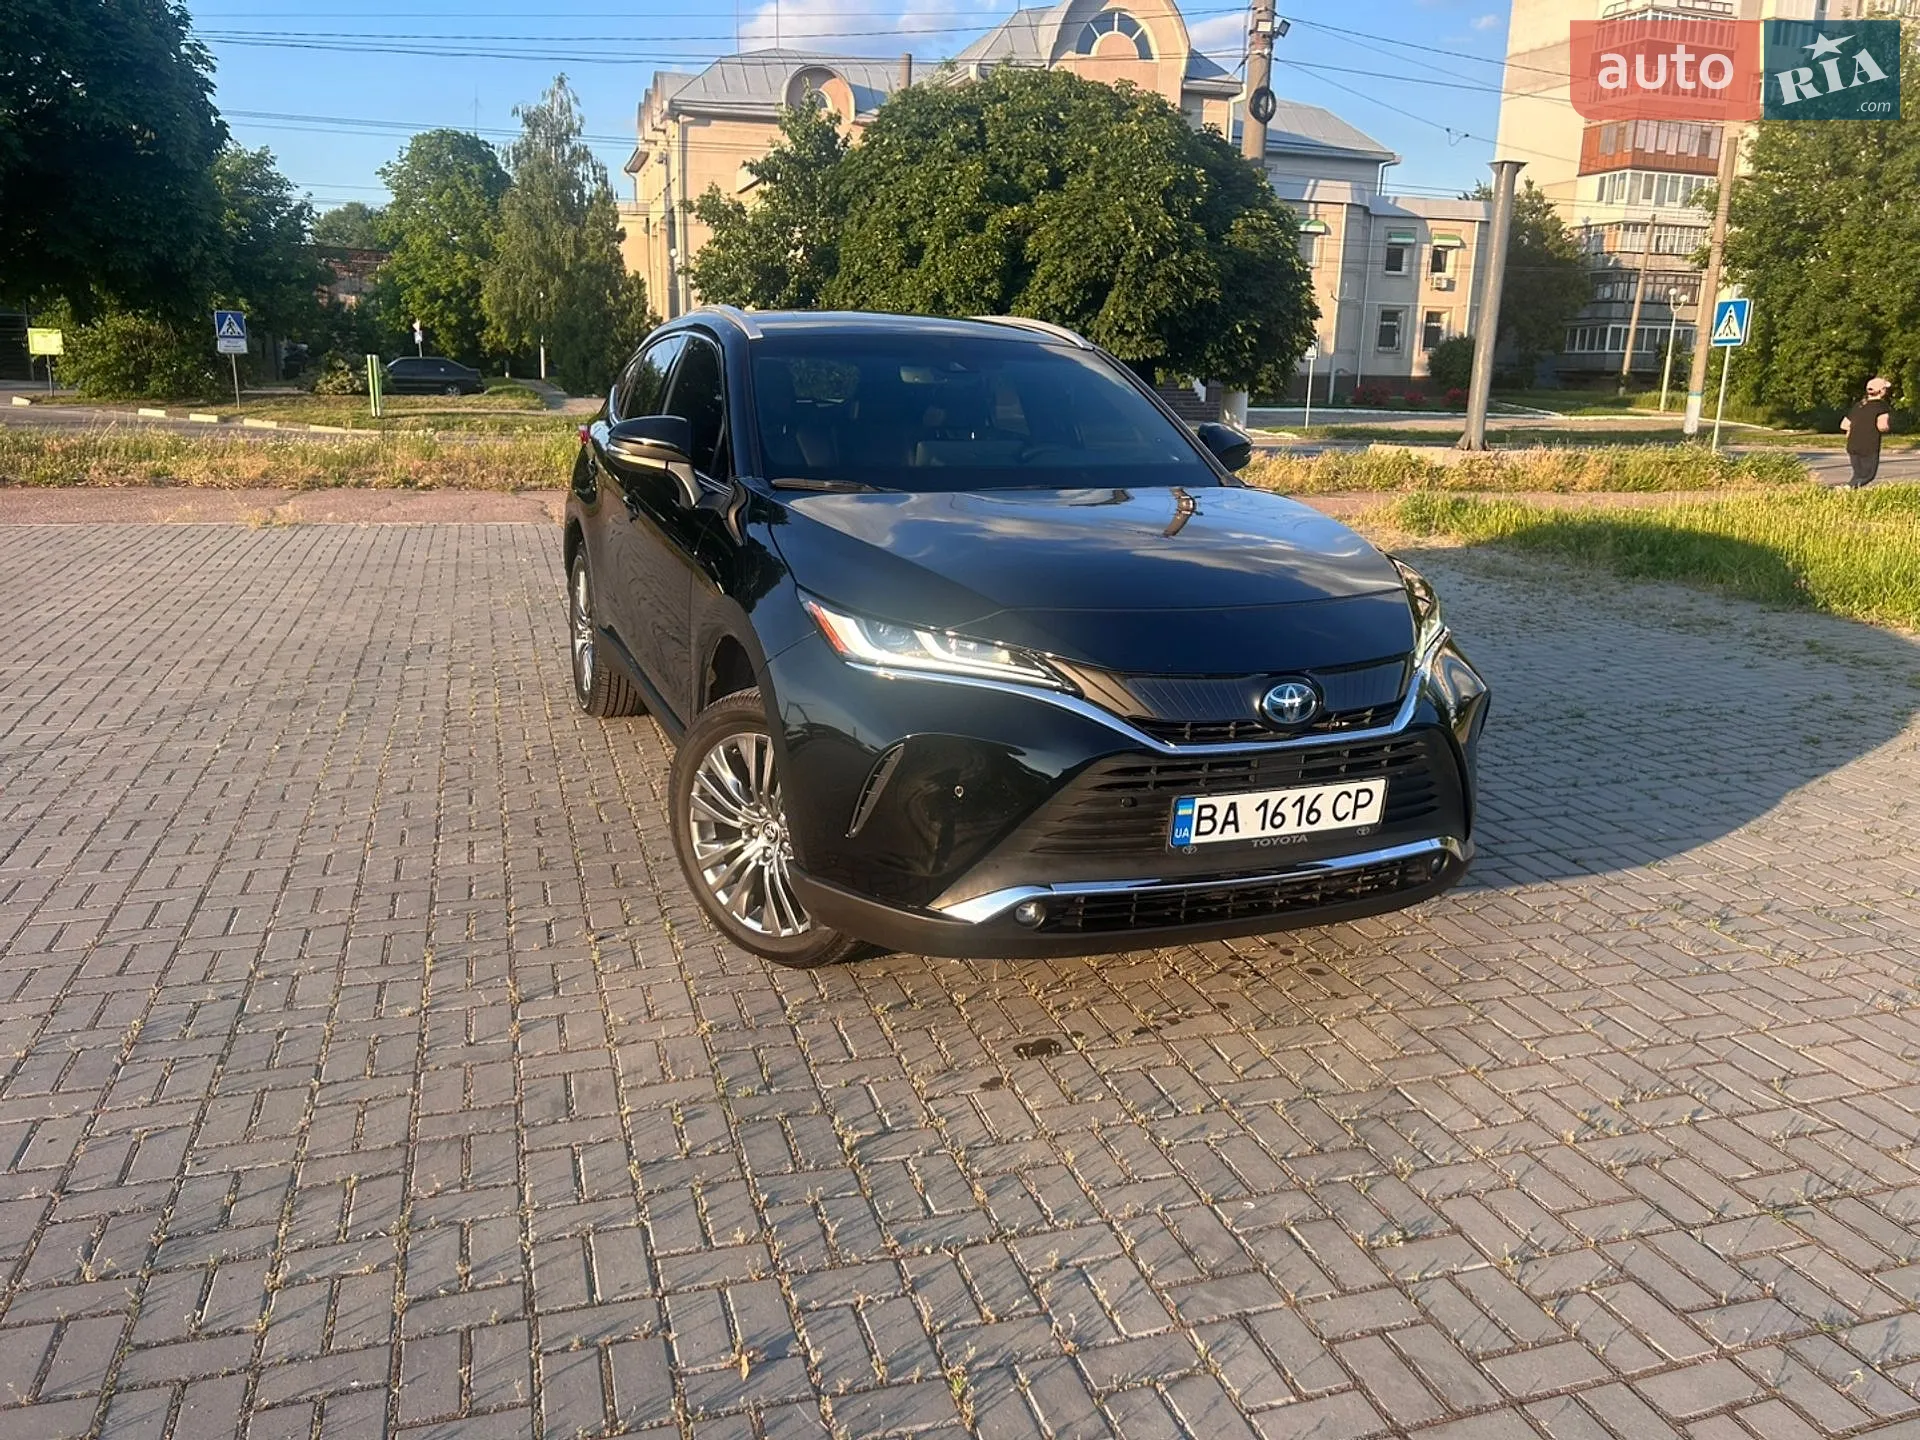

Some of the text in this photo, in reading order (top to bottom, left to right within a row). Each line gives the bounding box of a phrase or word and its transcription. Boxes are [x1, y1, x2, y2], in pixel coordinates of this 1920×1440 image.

[1195, 788, 1374, 837] BA 1616 CP
[1174, 827, 1189, 839] UA
[1252, 834, 1308, 847] TOYOTA
